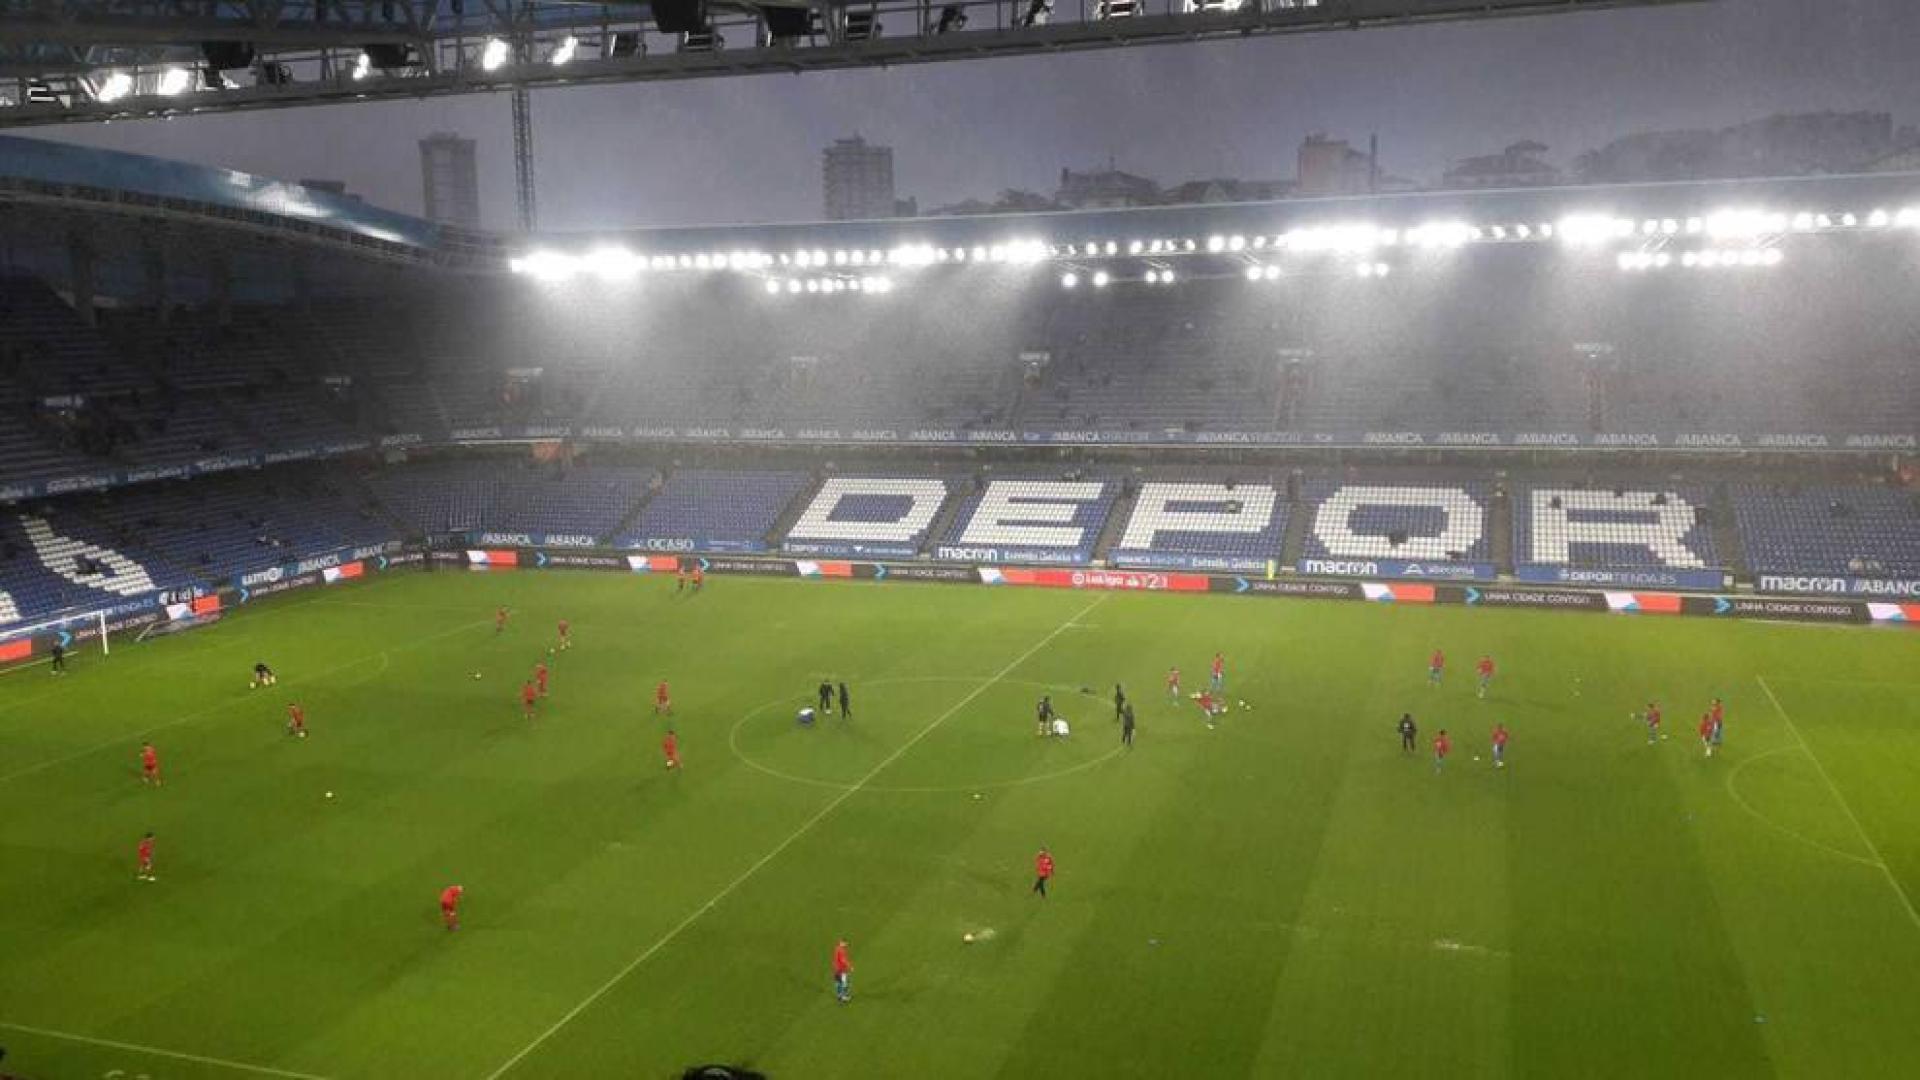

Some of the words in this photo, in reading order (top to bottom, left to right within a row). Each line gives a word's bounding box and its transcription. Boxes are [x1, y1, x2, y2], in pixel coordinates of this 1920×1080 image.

[481, 532, 531, 545] ABANCA
[544, 534, 595, 546] ABANCA
[648, 538, 695, 551] OCASO
[938, 546, 998, 561] macron
[1306, 559, 1378, 575] macron
[1761, 575, 1846, 592] macron
[1854, 579, 1920, 595] ABANC
